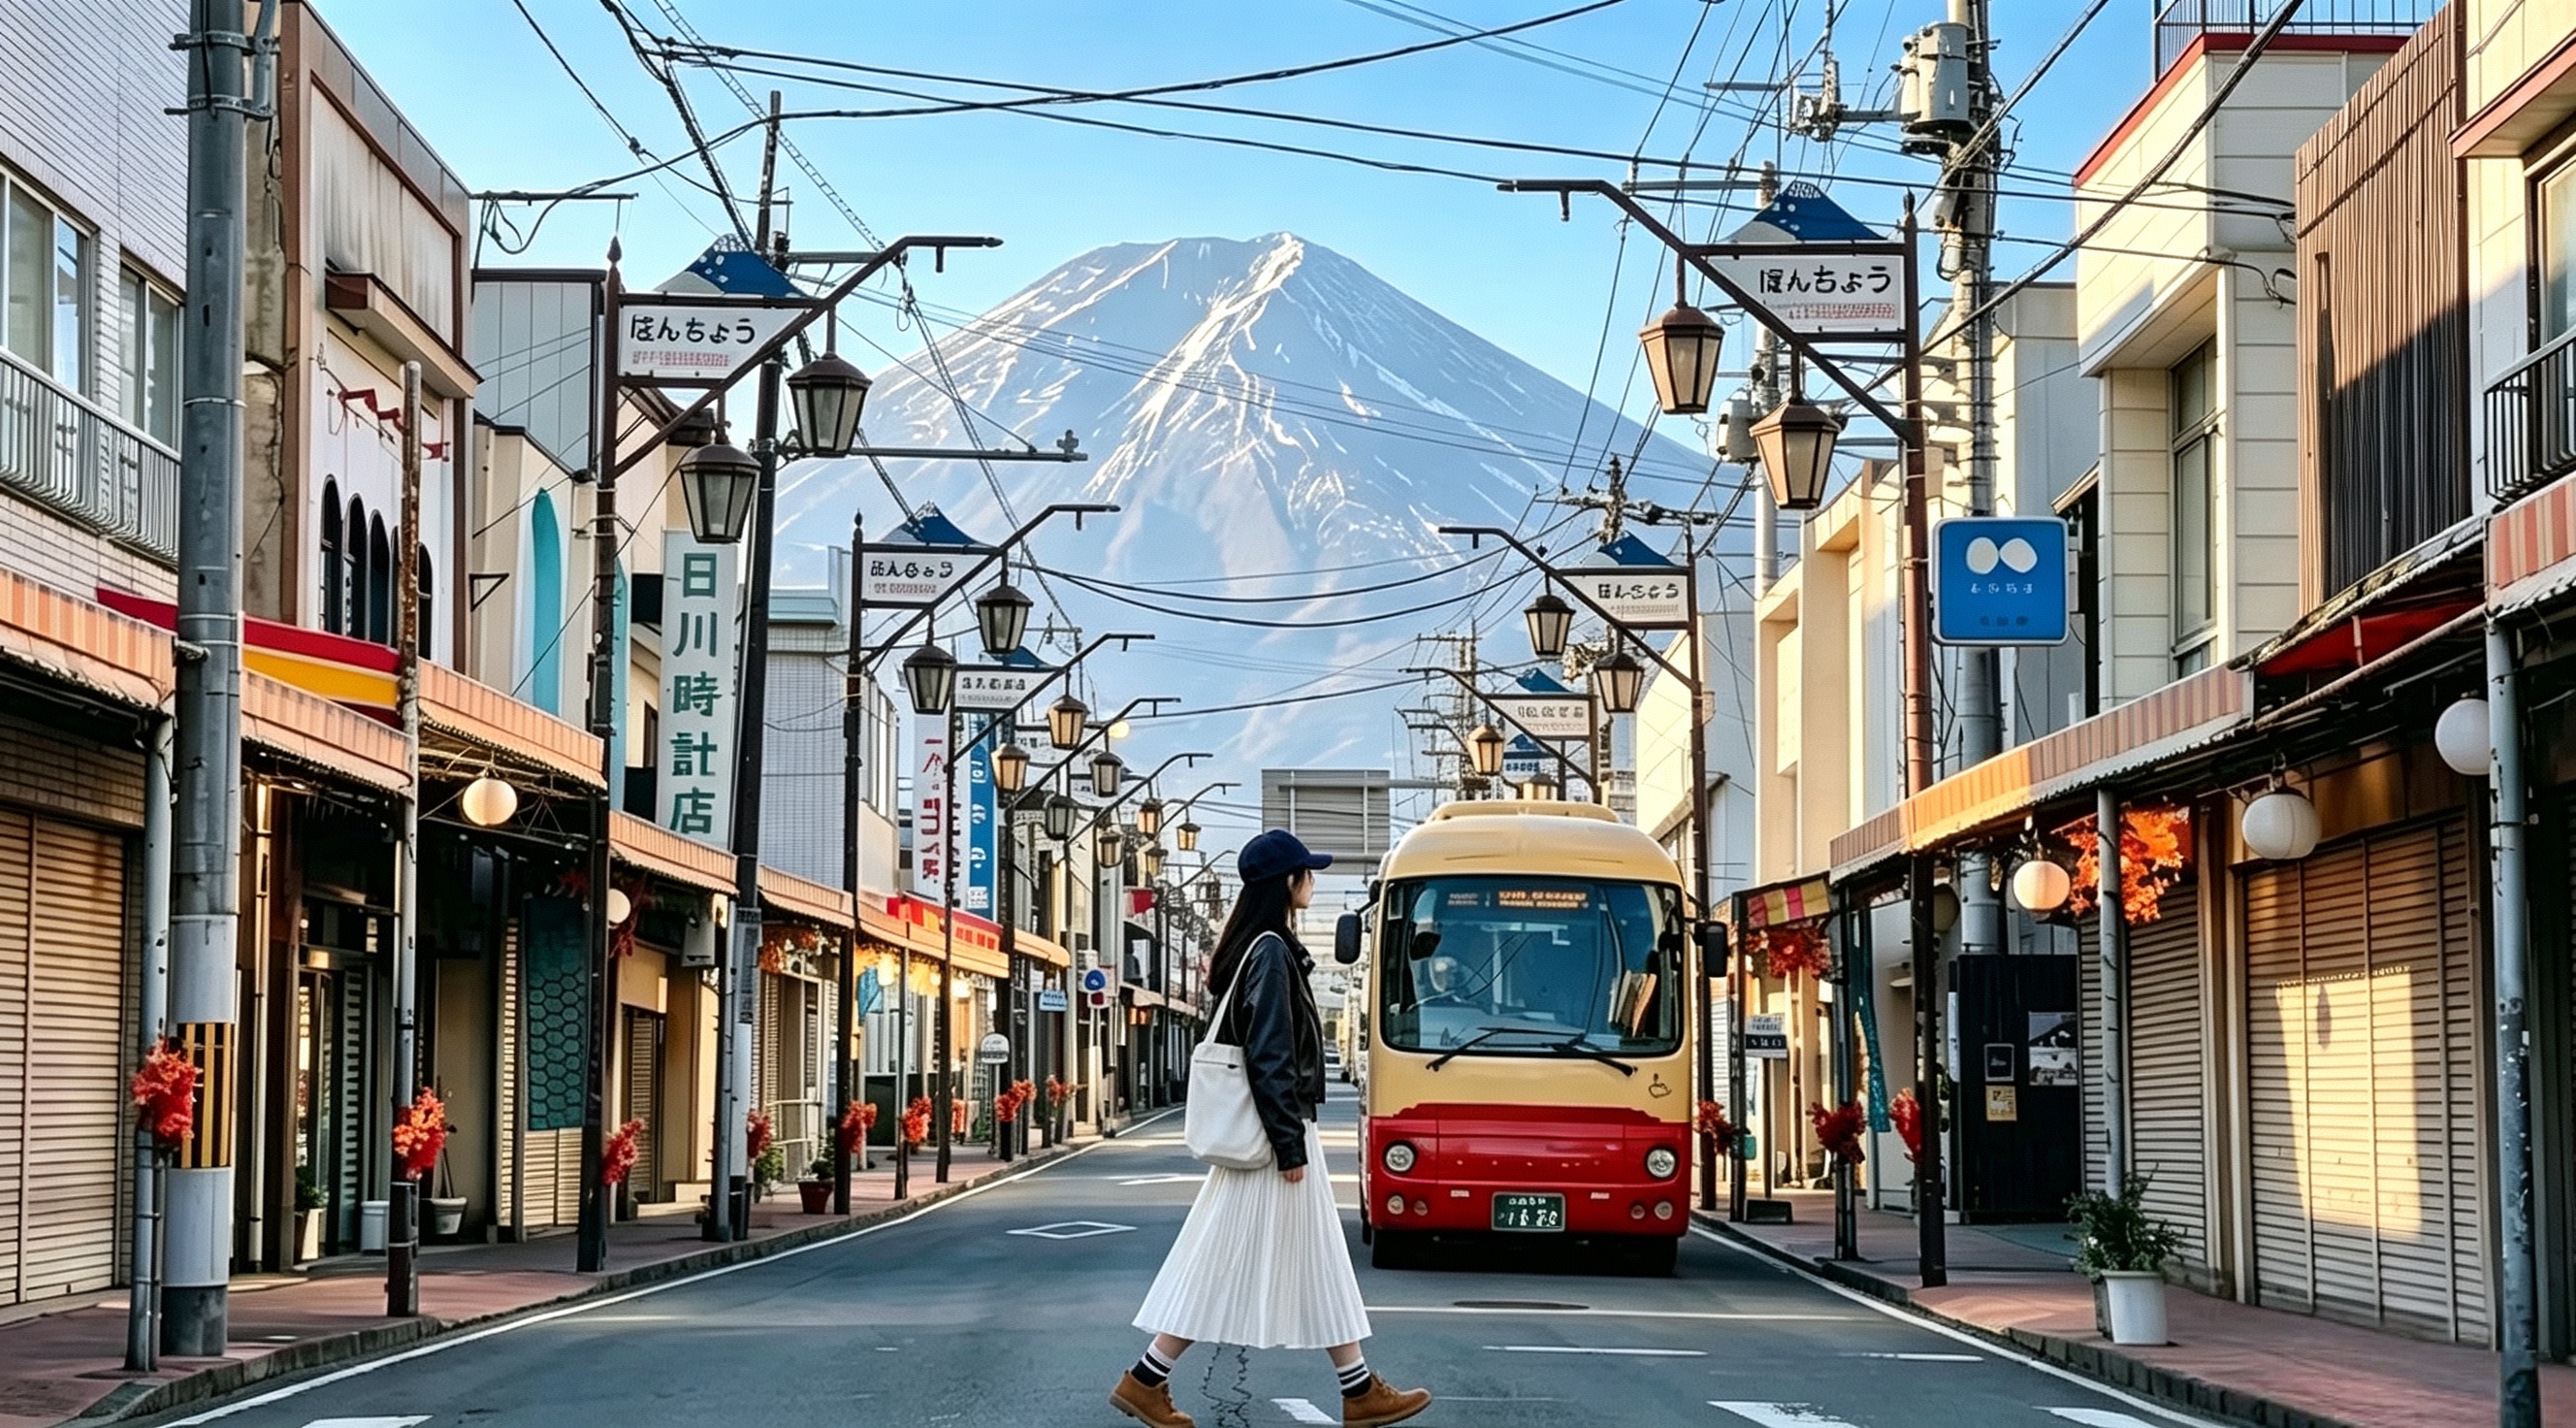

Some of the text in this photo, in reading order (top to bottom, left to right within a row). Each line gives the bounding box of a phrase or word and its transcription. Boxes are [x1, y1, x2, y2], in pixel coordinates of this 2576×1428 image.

[669, 552, 723, 834] 日川時計店
